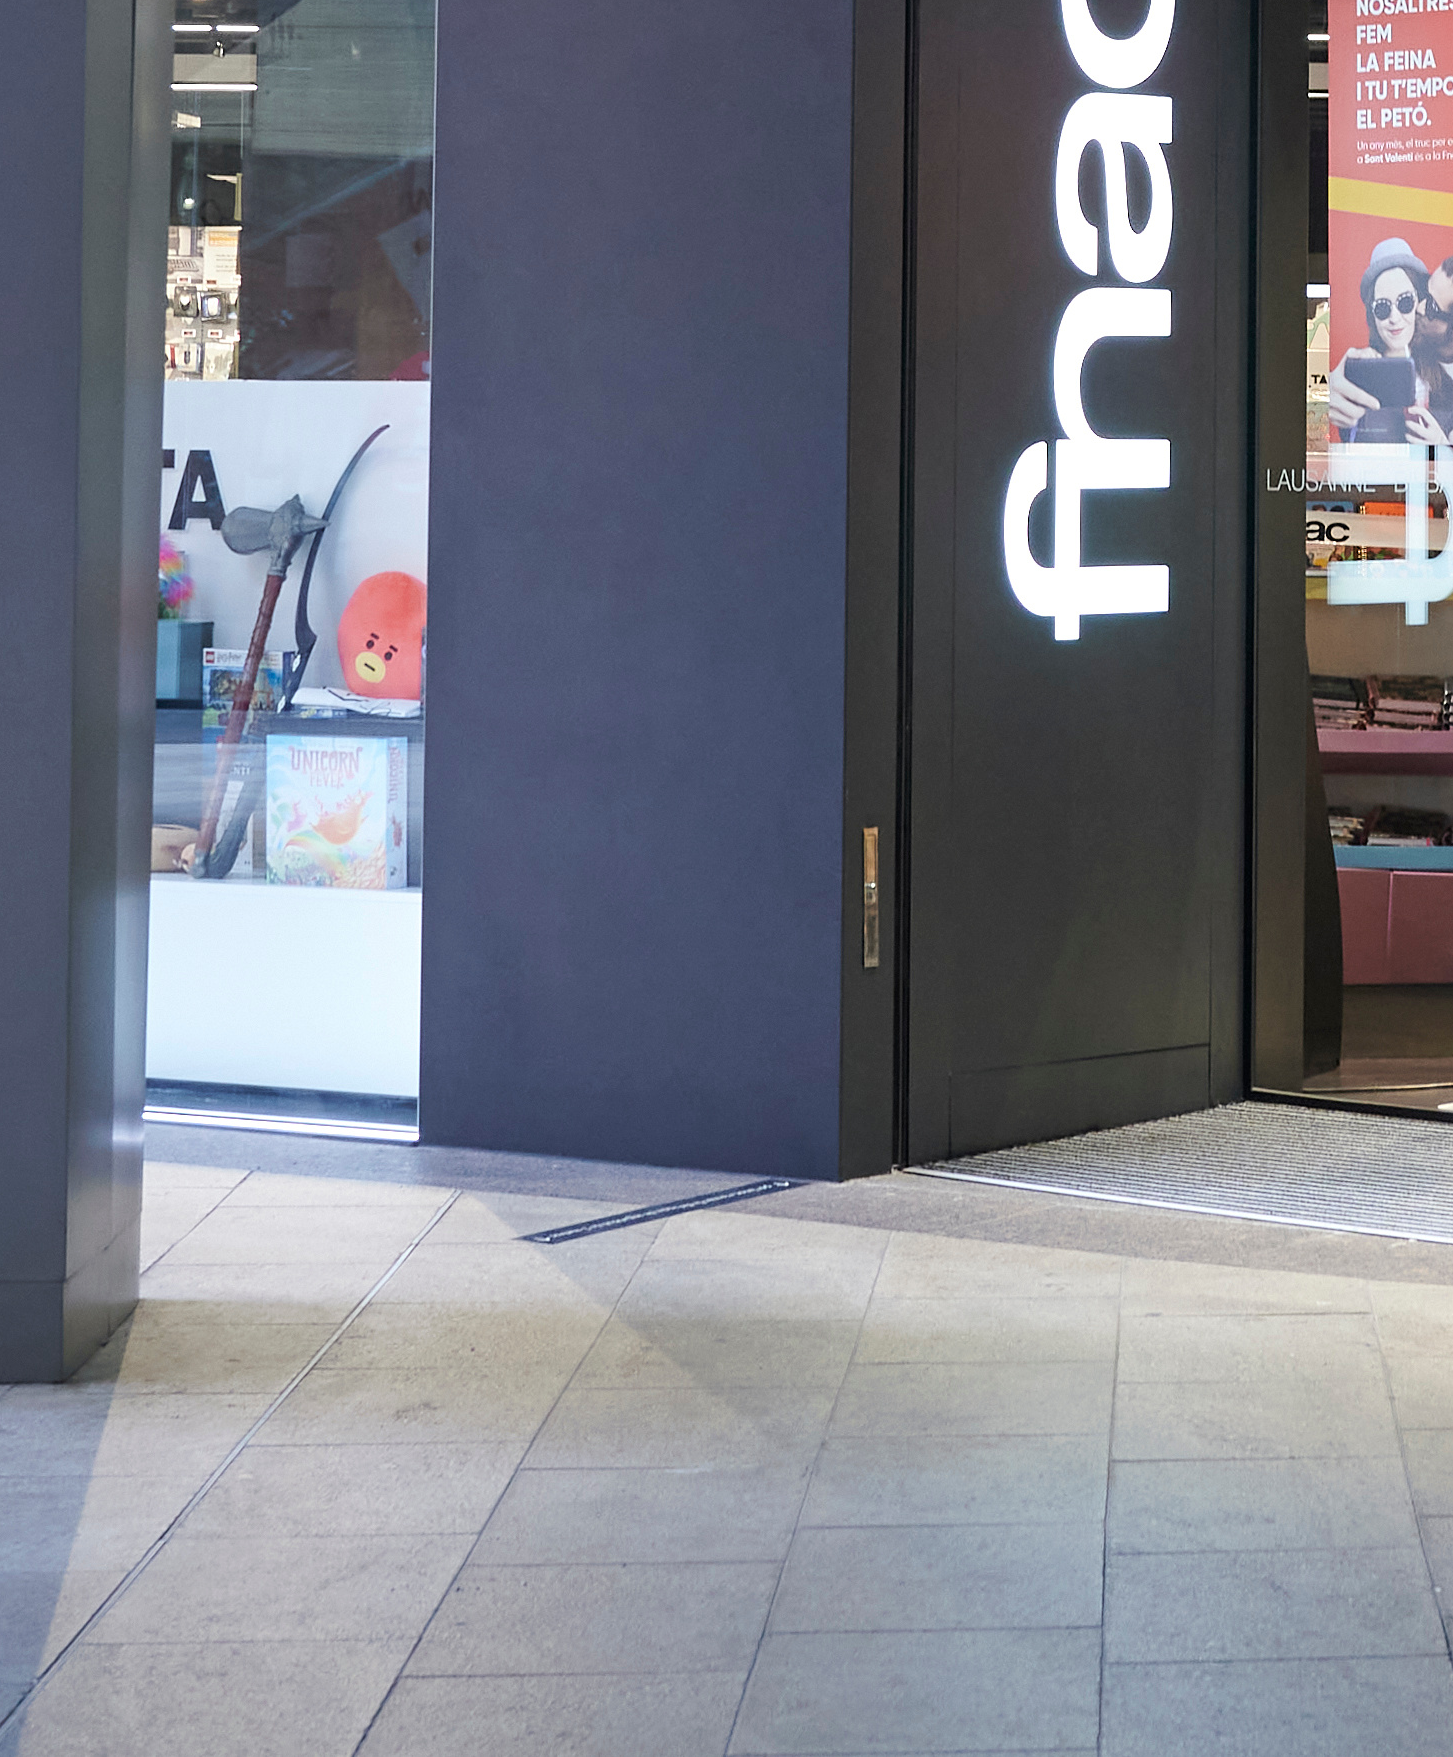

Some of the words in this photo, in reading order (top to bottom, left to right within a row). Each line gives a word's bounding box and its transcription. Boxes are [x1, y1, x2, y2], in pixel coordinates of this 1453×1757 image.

[1357, 24, 1392, 44] FEM
[1357, 53, 1379, 72] LA
[1385, 49, 1436, 71] FEINA
[1357, 82, 1361, 101] I
[1365, 81, 1387, 100] TU
[1357, 109, 1376, 129] EL
[1381, 102, 1432, 128] PETÓ.
[289, 746, 363, 775] UNICORN
[309, 767, 344, 787] FEVER
